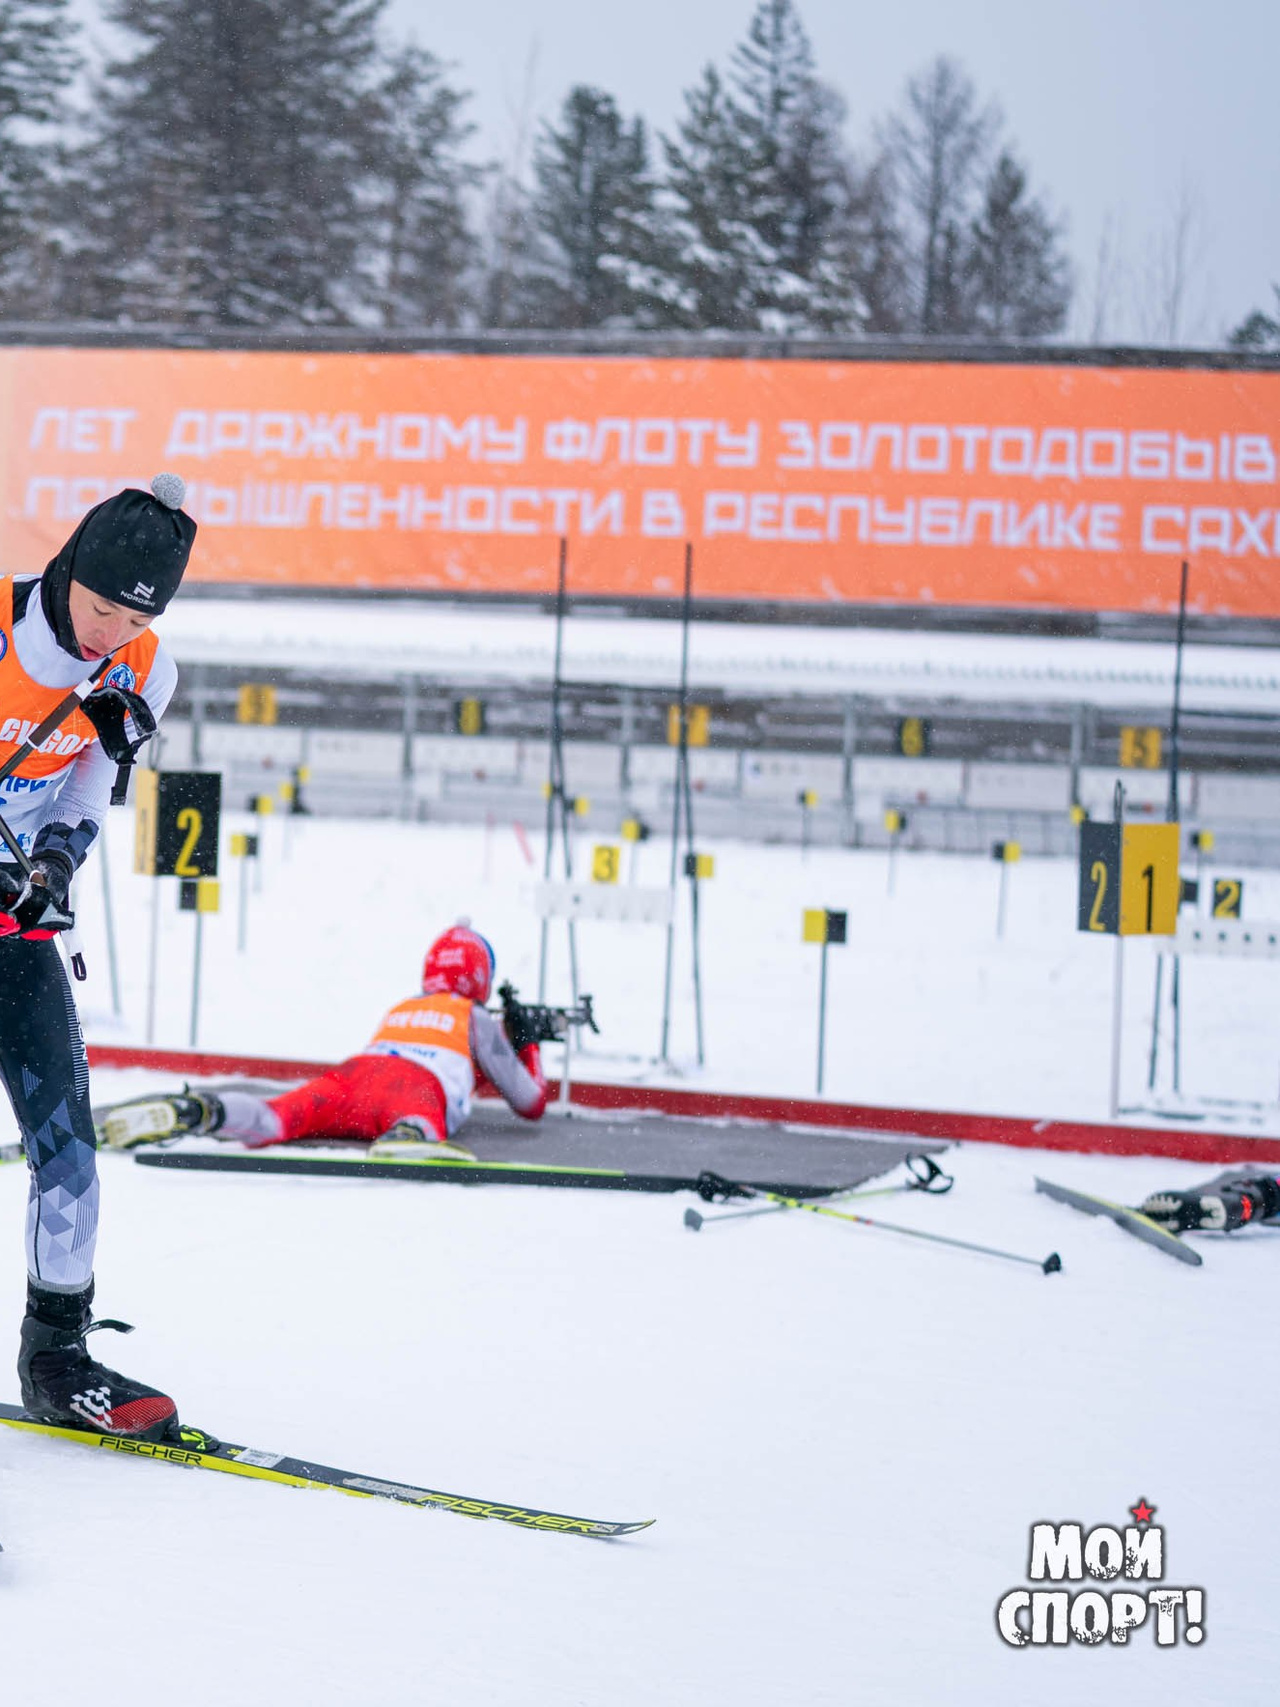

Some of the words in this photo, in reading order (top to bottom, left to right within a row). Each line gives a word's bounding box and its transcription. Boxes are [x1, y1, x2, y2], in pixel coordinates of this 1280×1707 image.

[28, 408, 139, 454] ЛЕТ
[164, 409, 528, 464] ДРАЖНОМУ
[544, 417, 759, 468] ФЛОТУ
[777, 421, 1277, 484] ЗОЛОТОДОБЫВ
[24, 475, 625, 538] ПРЫШЛЕННОСТИ
[641, 489, 685, 538] В
[702, 491, 1123, 551] РЕСПУБЛИКЕ
[1141, 504, 1280, 558] САХ
[120, 590, 156, 608] NORDSKI
[175, 807, 203, 876] 2
[596, 849, 615, 881] 3
[1089, 861, 1108, 931] 2
[1141, 864, 1155, 933] 1
[1214, 880, 1240, 918] 2
[99, 1436, 202, 1465] FISCHER
[420, 1494, 600, 1532] FISCHER
